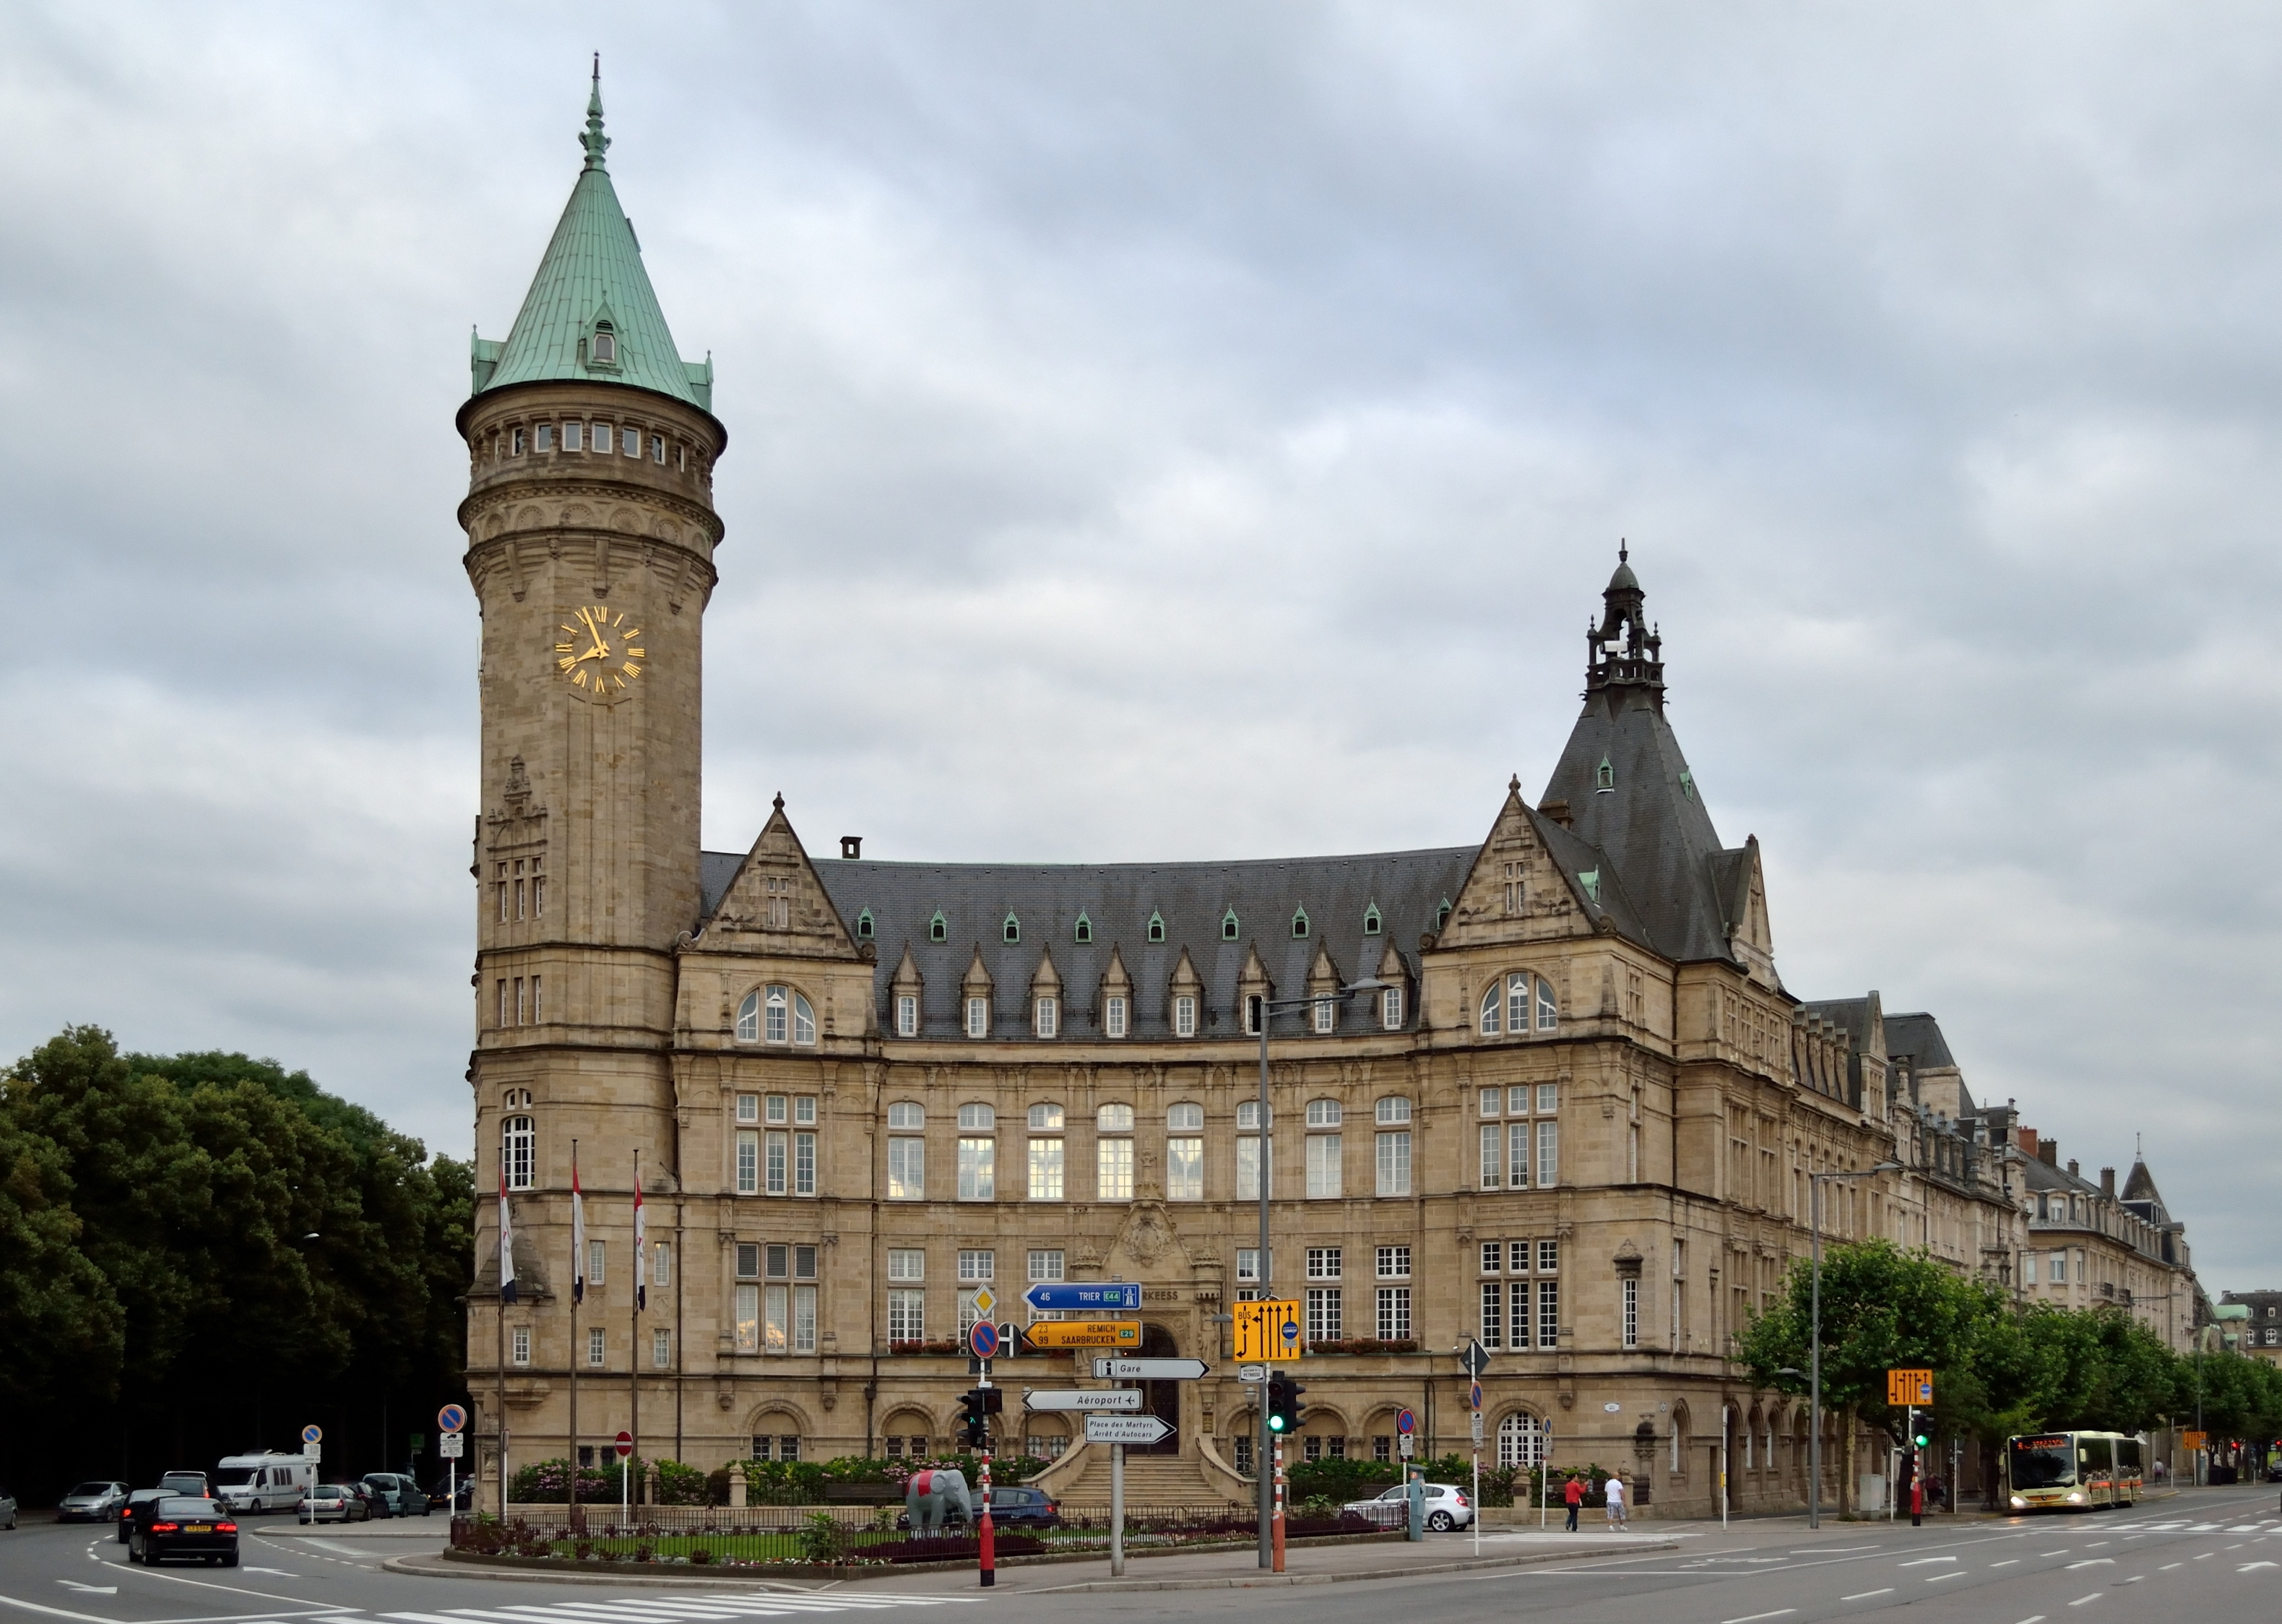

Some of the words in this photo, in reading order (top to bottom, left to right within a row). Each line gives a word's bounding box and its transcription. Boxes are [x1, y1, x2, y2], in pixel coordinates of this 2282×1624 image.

[1040, 1292, 1050, 1301] 46
[1143, 1291, 1178, 1300] RKEESS
[1238, 1311, 1251, 1320] BUS
[1038, 1325, 1048, 1334] 23
[1061, 1336, 1115, 1344] SAARBRUCKEN
[1077, 1396, 1122, 1406] Aéroport
